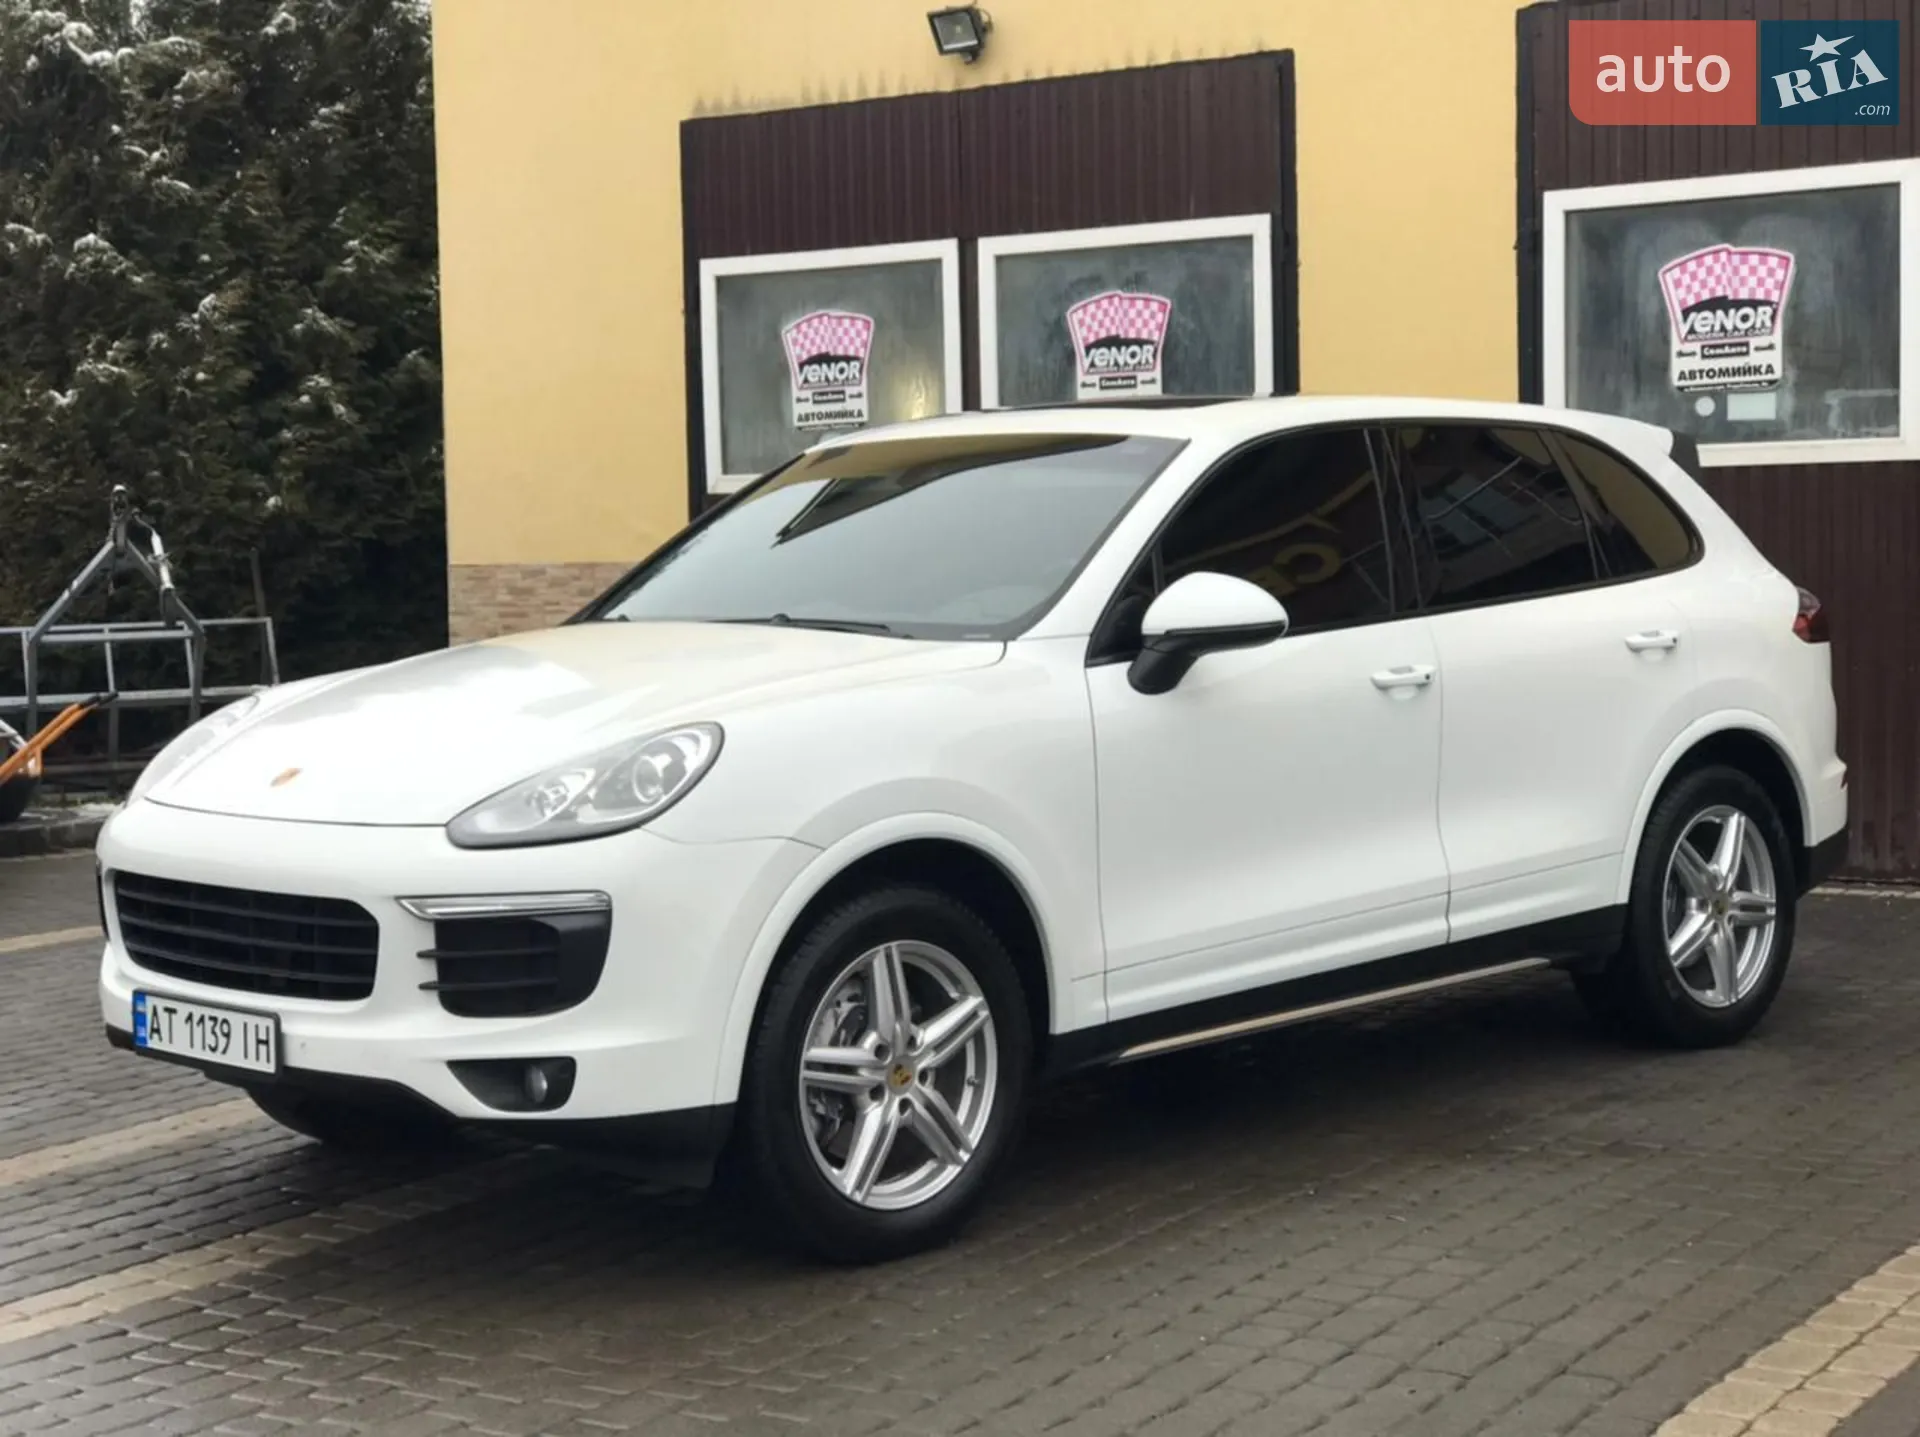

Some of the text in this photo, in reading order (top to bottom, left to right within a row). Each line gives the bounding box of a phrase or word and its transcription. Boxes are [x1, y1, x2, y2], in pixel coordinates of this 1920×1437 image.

[1677, 362, 1775, 382] АВТОМИЙКА
[797, 407, 864, 423] АВТОМИЙКА
[149, 1004, 271, 1065] AT 1139 IH
